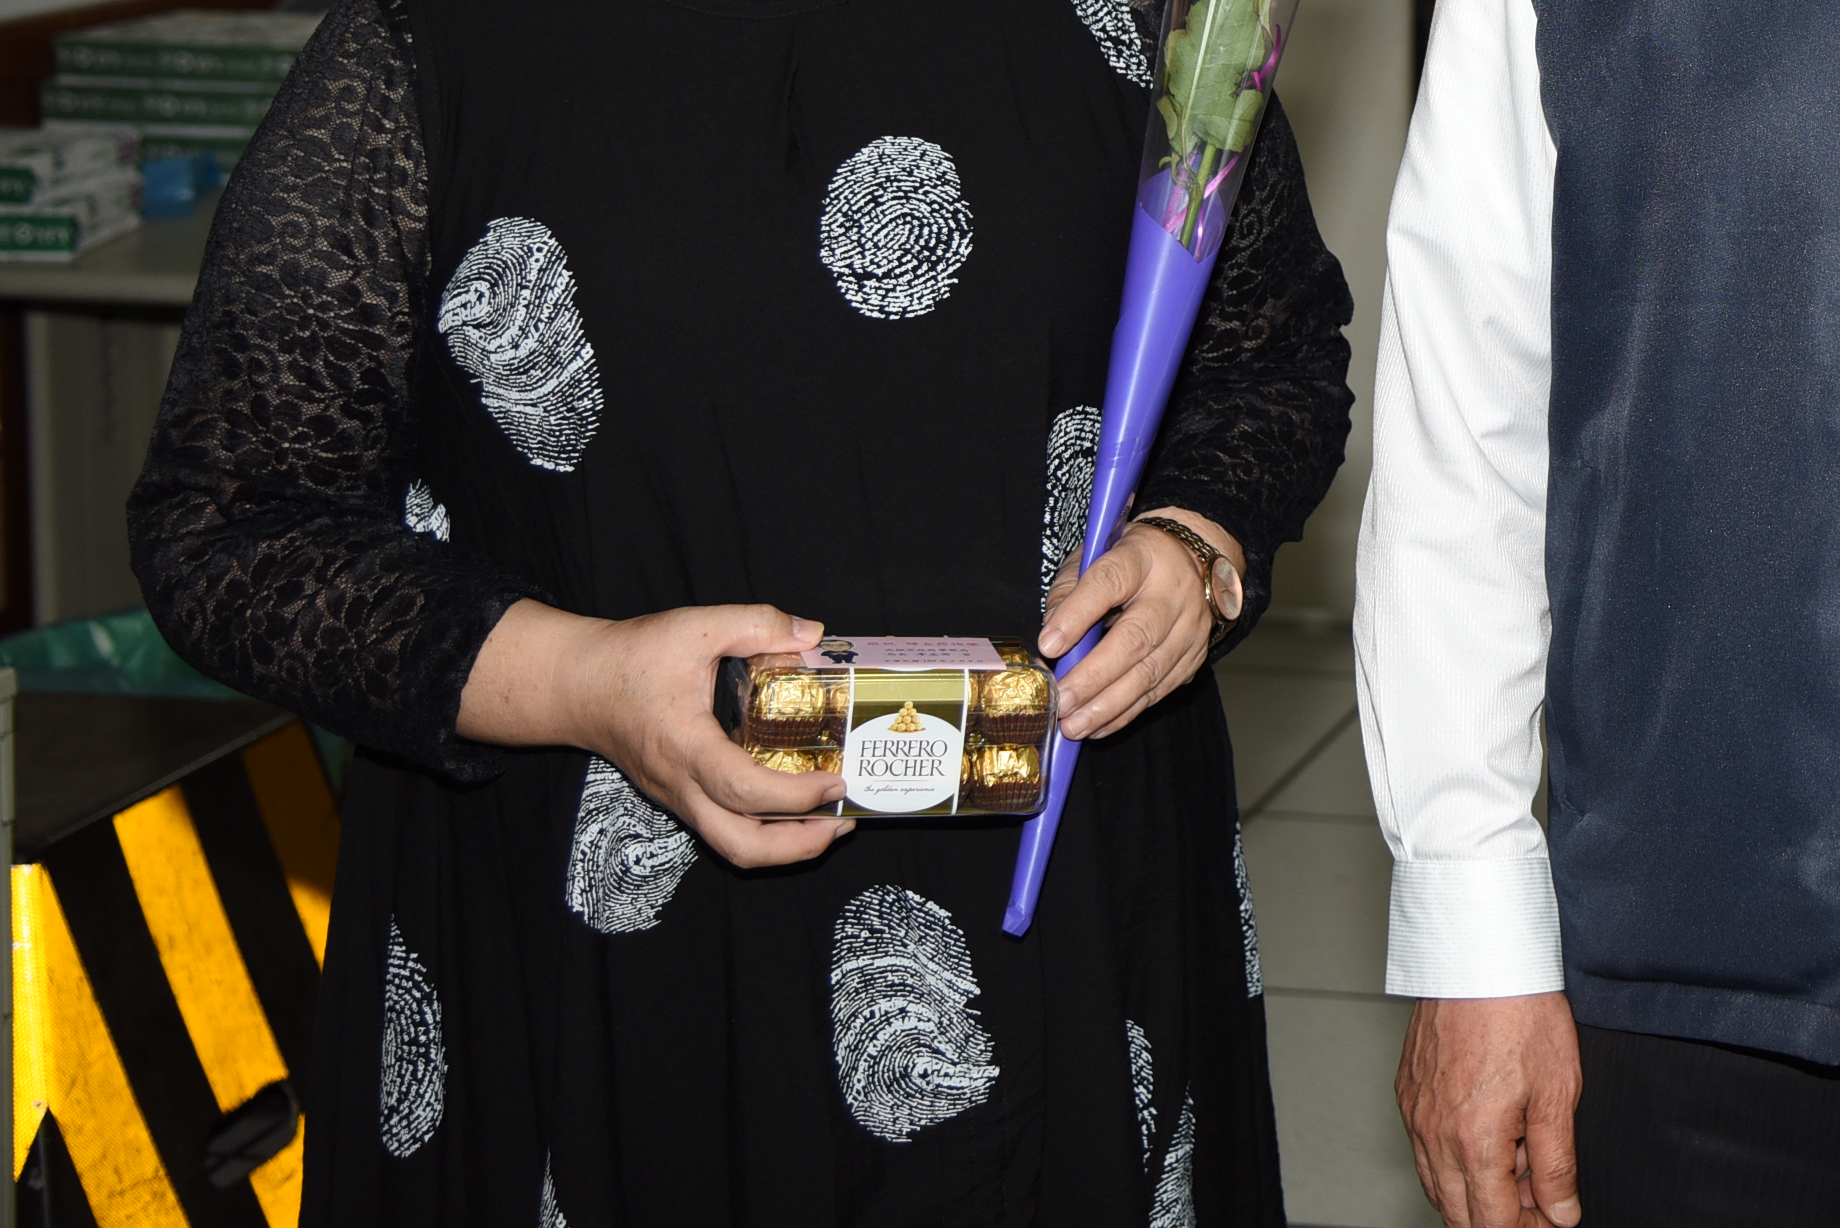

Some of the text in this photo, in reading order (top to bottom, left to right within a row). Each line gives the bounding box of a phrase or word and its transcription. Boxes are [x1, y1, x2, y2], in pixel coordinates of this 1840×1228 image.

[860, 739, 948, 758] FERRERO
[858, 758, 946, 777] ROCHER
[864, 784, 936, 796] the golden experience
